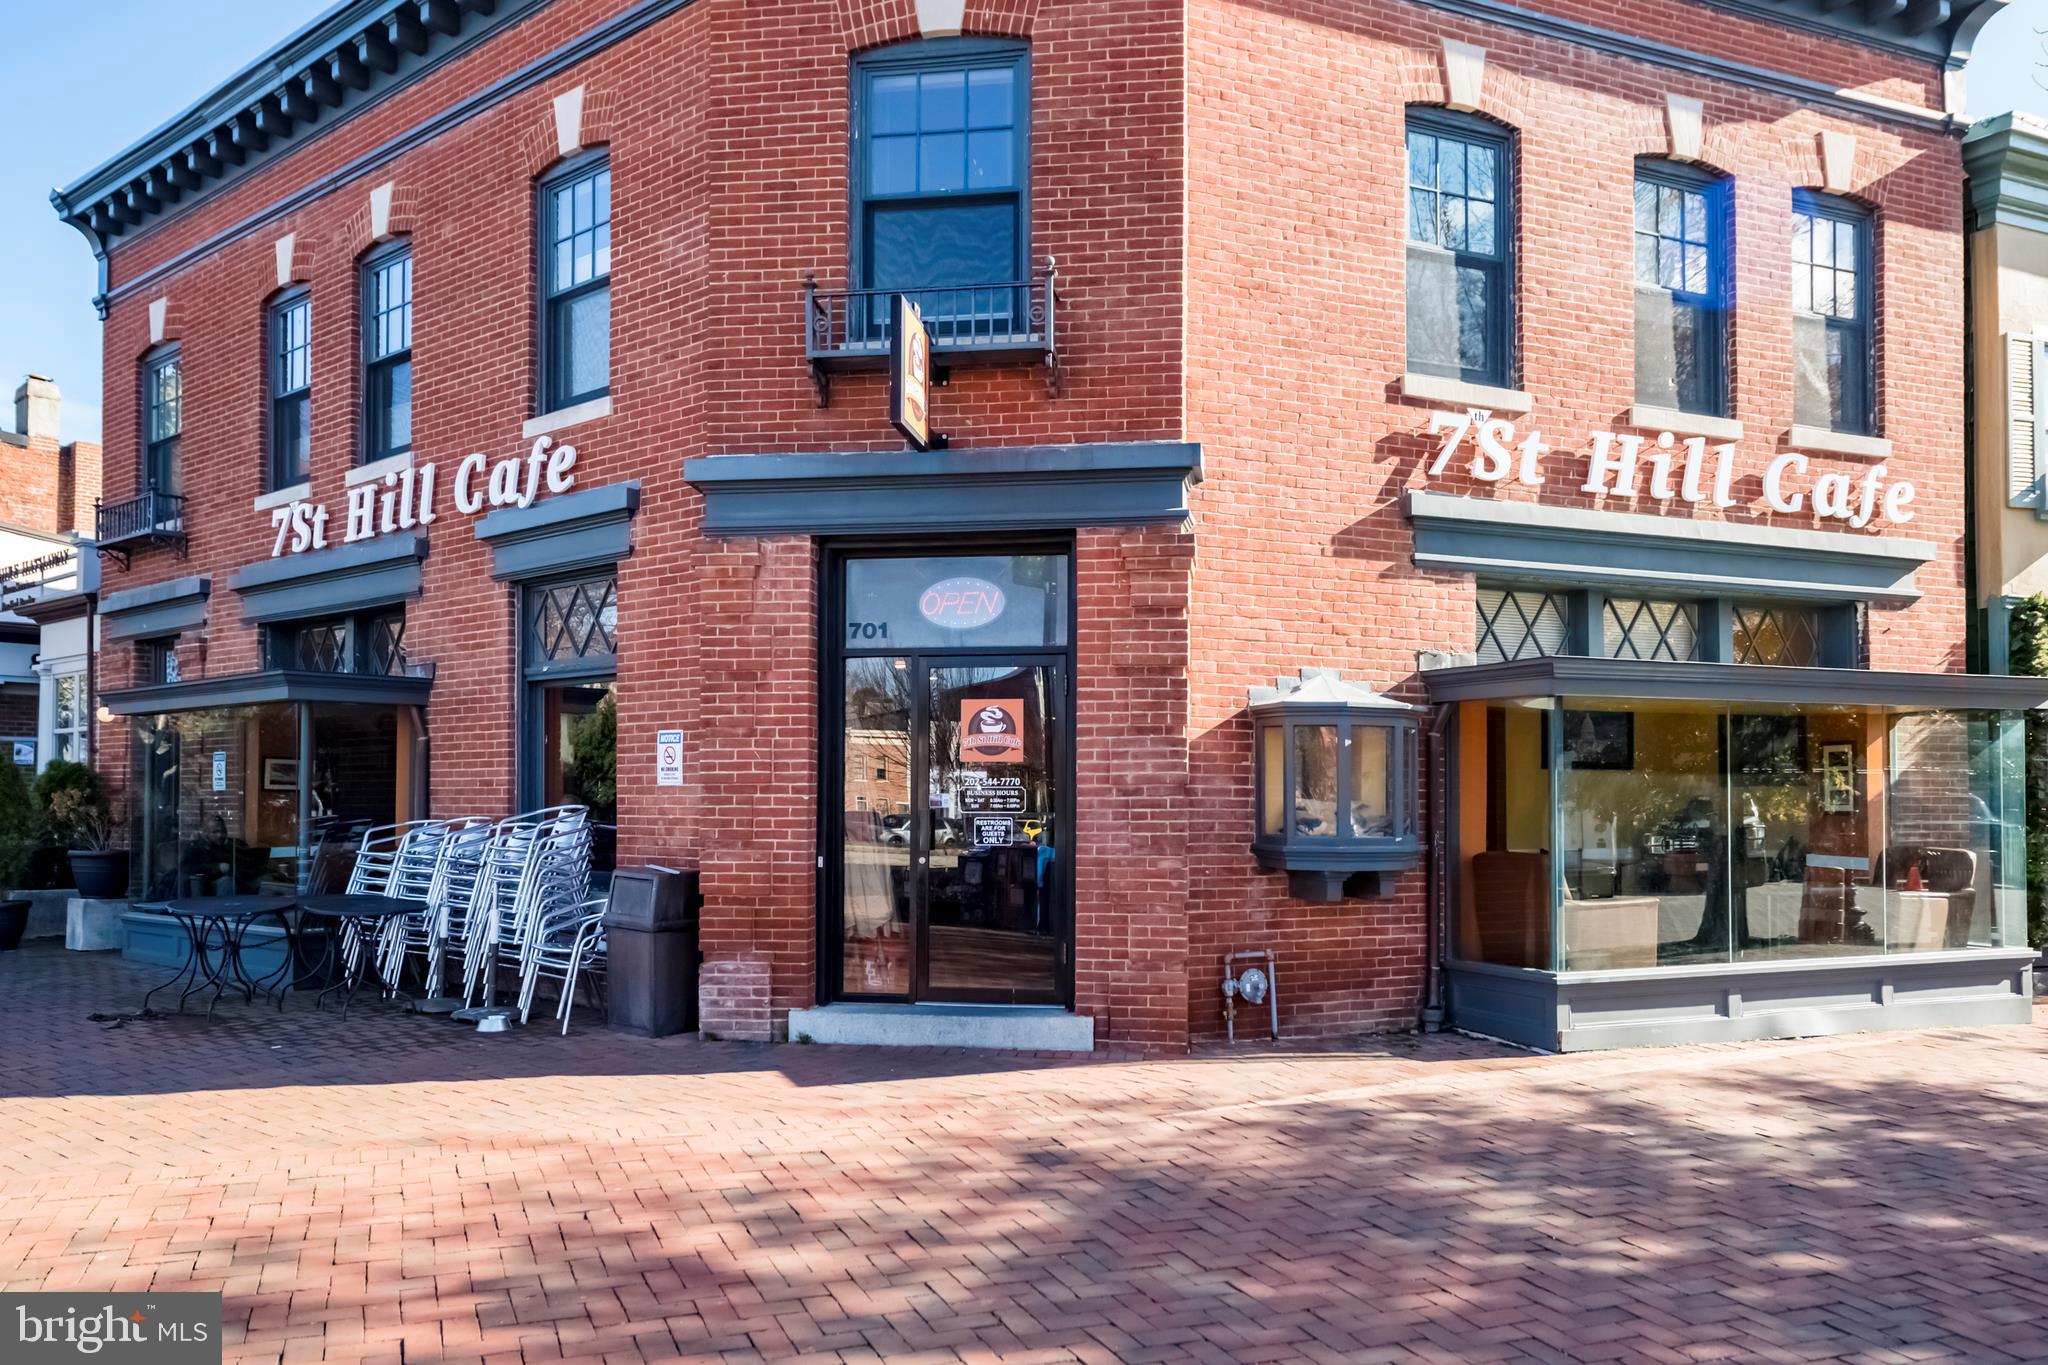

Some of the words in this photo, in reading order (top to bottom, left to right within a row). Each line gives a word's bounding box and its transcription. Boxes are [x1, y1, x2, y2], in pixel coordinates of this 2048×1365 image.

[344, 462, 437, 543] Hill
[454, 435, 577, 514] Cafe
[1581, 430, 1736, 508] Hill
[1762, 452, 1916, 529] Cafe
[922, 590, 1000, 617] OPEN
[848, 622, 888, 639] 701
[660, 733, 681, 743] NOTICE
[965, 778, 1021, 786] 202-544-7770
